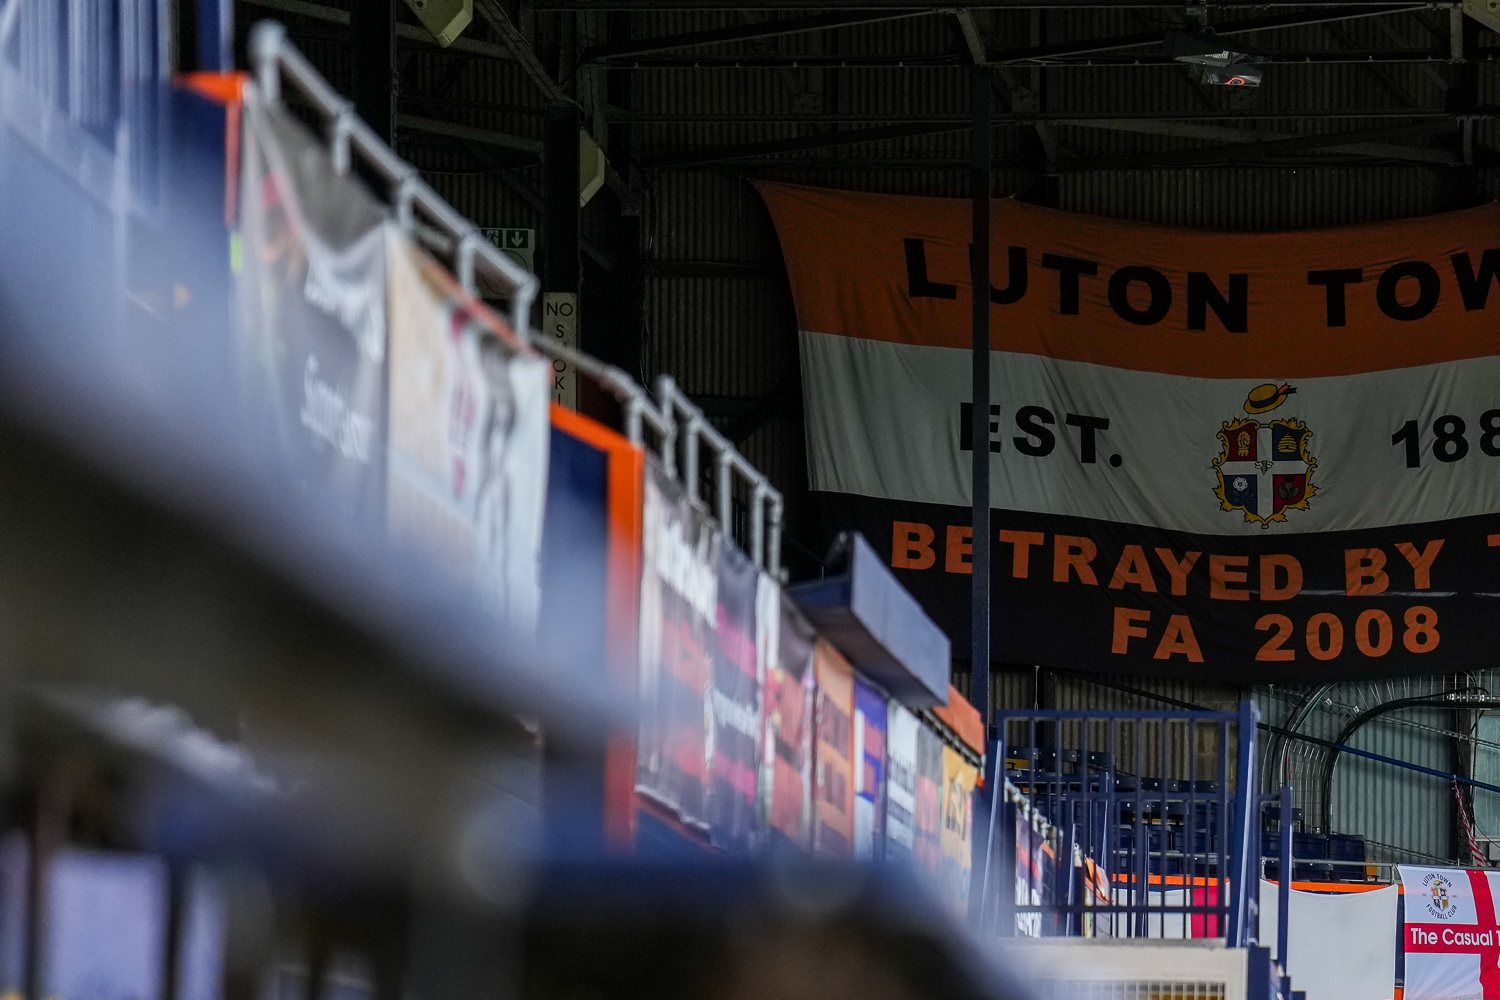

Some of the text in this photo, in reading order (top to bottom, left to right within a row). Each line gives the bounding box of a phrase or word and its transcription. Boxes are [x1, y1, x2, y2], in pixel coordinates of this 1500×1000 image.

[546, 302, 574, 317] NO
[904, 237, 1249, 334] LUTON
[960, 401, 1124, 467] EST.
[890, 519, 1304, 602] BETRAYED
[1344, 539, 1446, 596] BY
[1111, 604, 1442, 663] FA 2008
[1410, 927, 1438, 945] The
[1442, 928, 1494, 946] Casual
